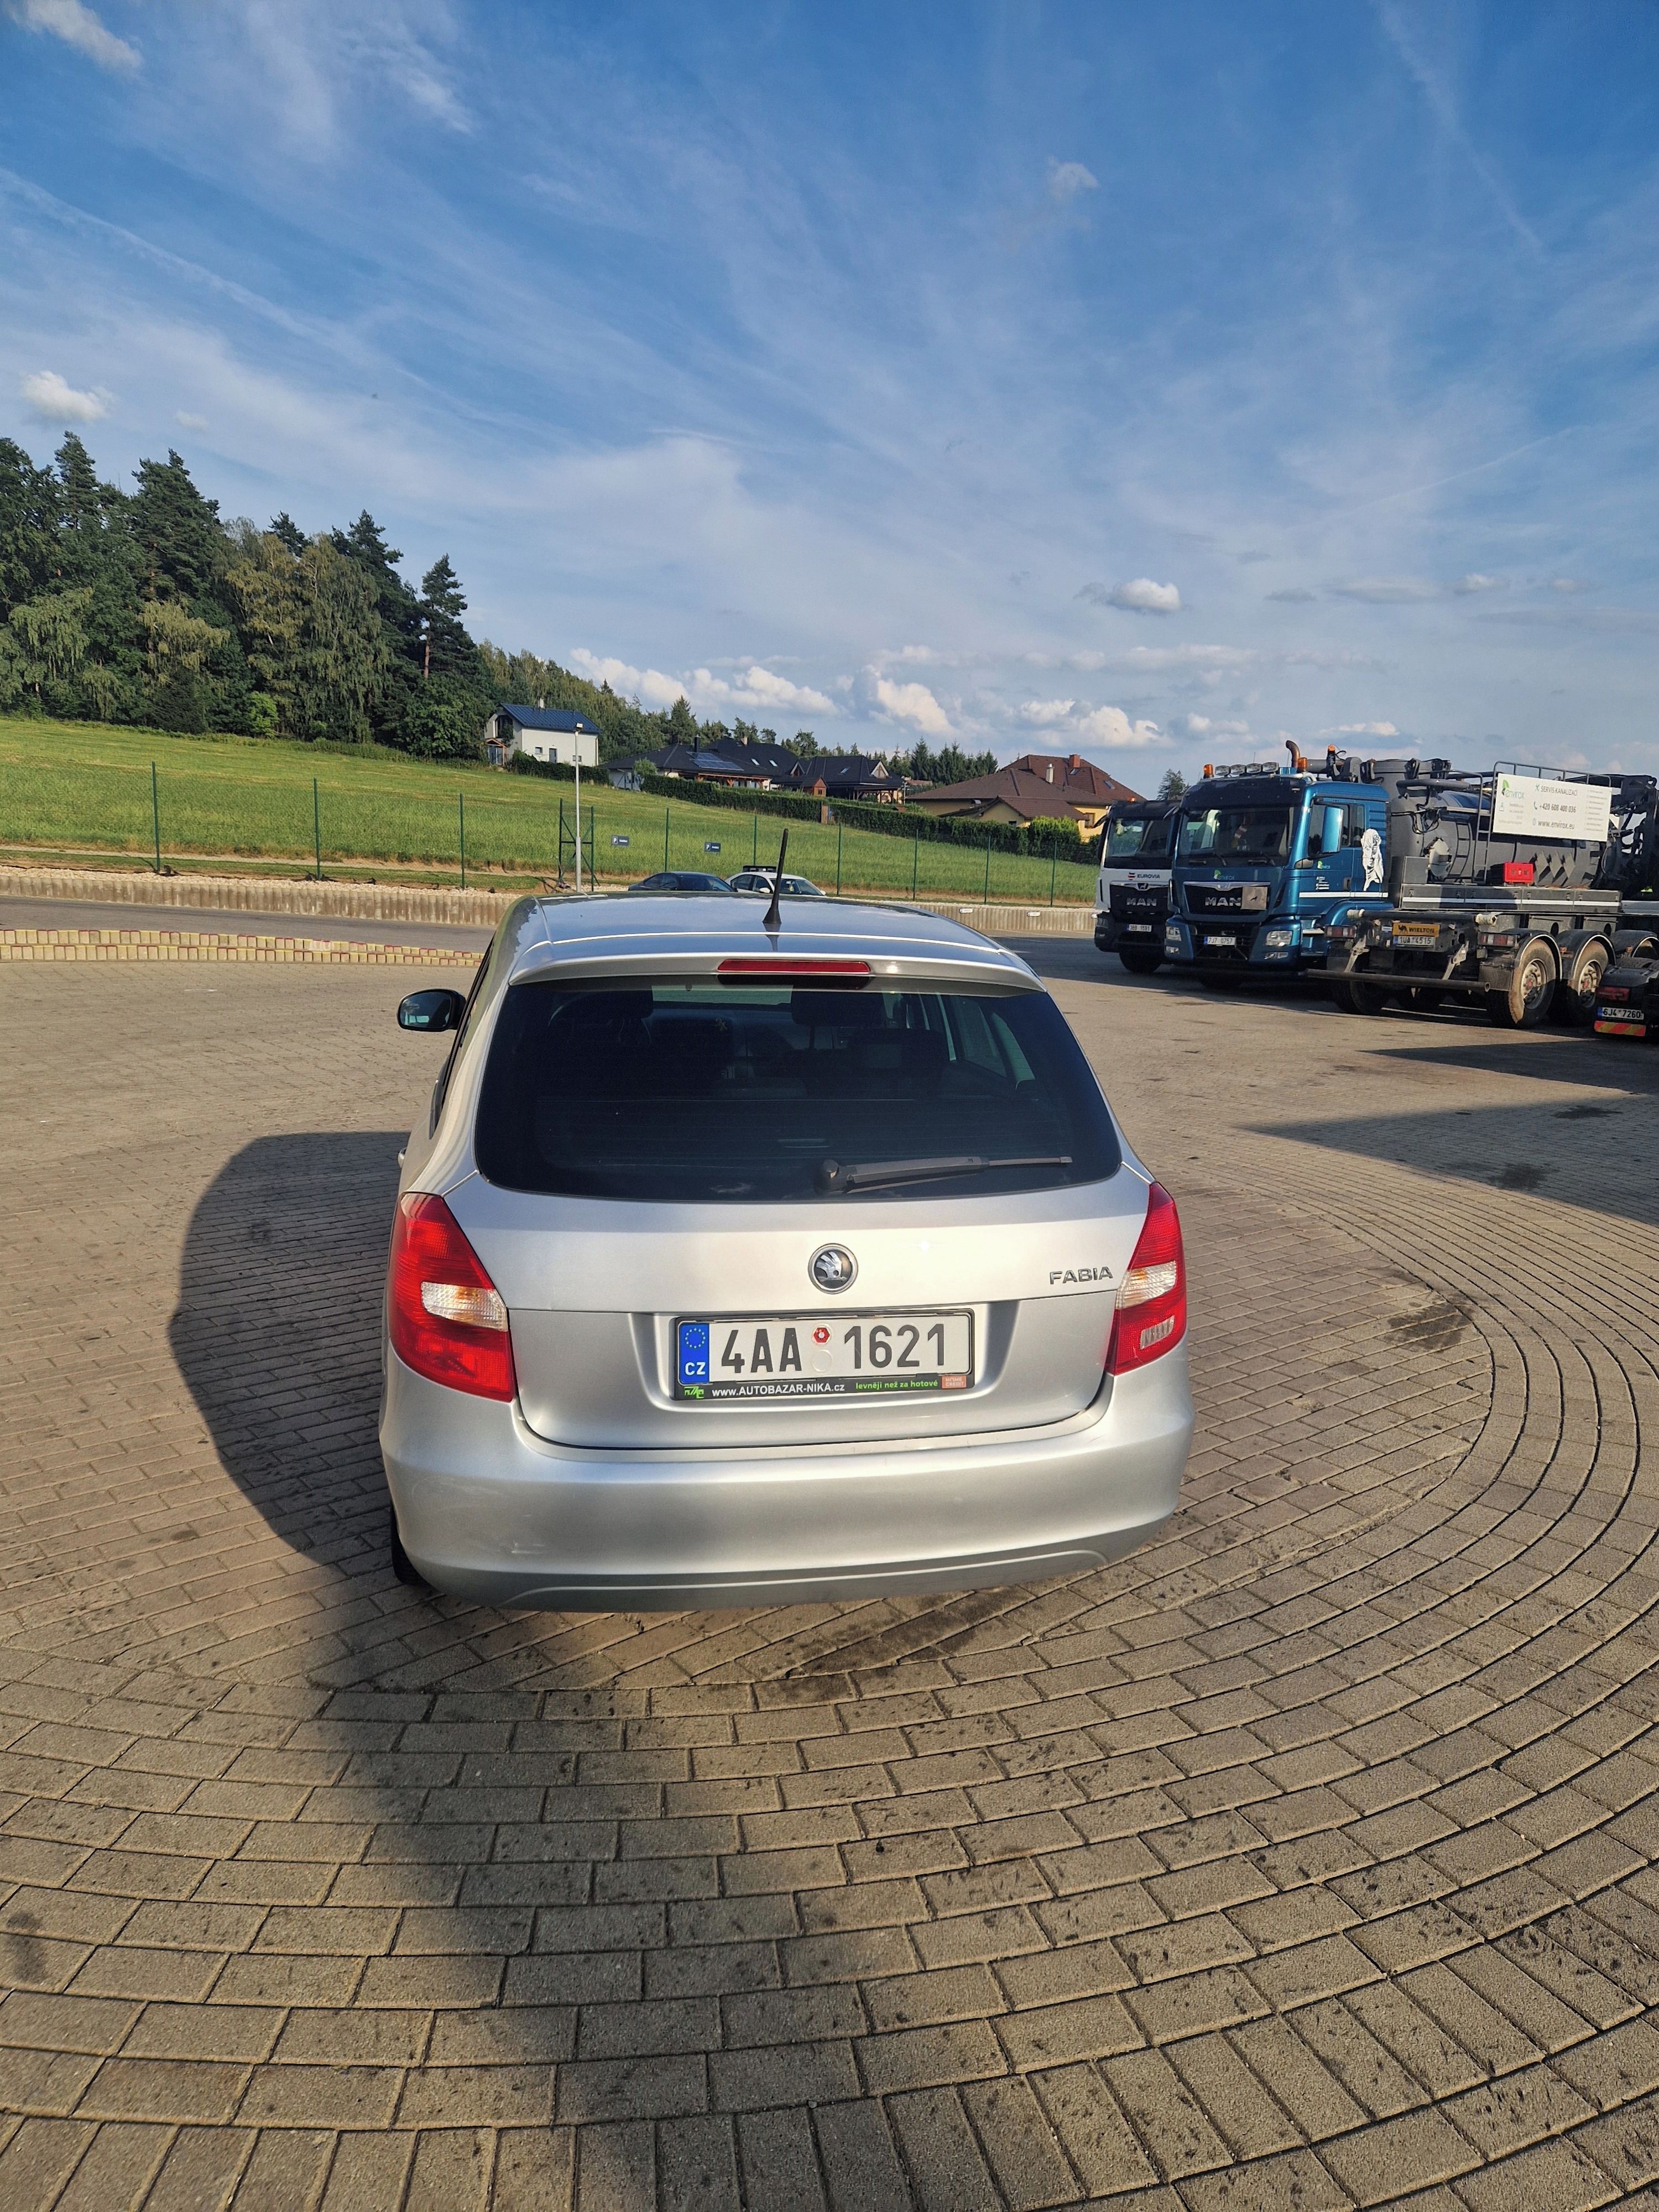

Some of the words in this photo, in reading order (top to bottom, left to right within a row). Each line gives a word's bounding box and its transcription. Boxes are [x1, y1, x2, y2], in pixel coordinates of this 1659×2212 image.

[1538, 820, 1575, 830] www.envirox.eu
[1126, 898, 1157, 906] MAN
[1205, 896, 1241, 906] MAN
[1604, 1008, 1617, 1016] 6J4
[1623, 1009, 1641, 1018] 7260
[1050, 1266, 1113, 1285] FABIA
[722, 1327, 802, 1374] 4AA
[844, 1323, 944, 1369] 1621
[685, 1361, 706, 1375] CZ
